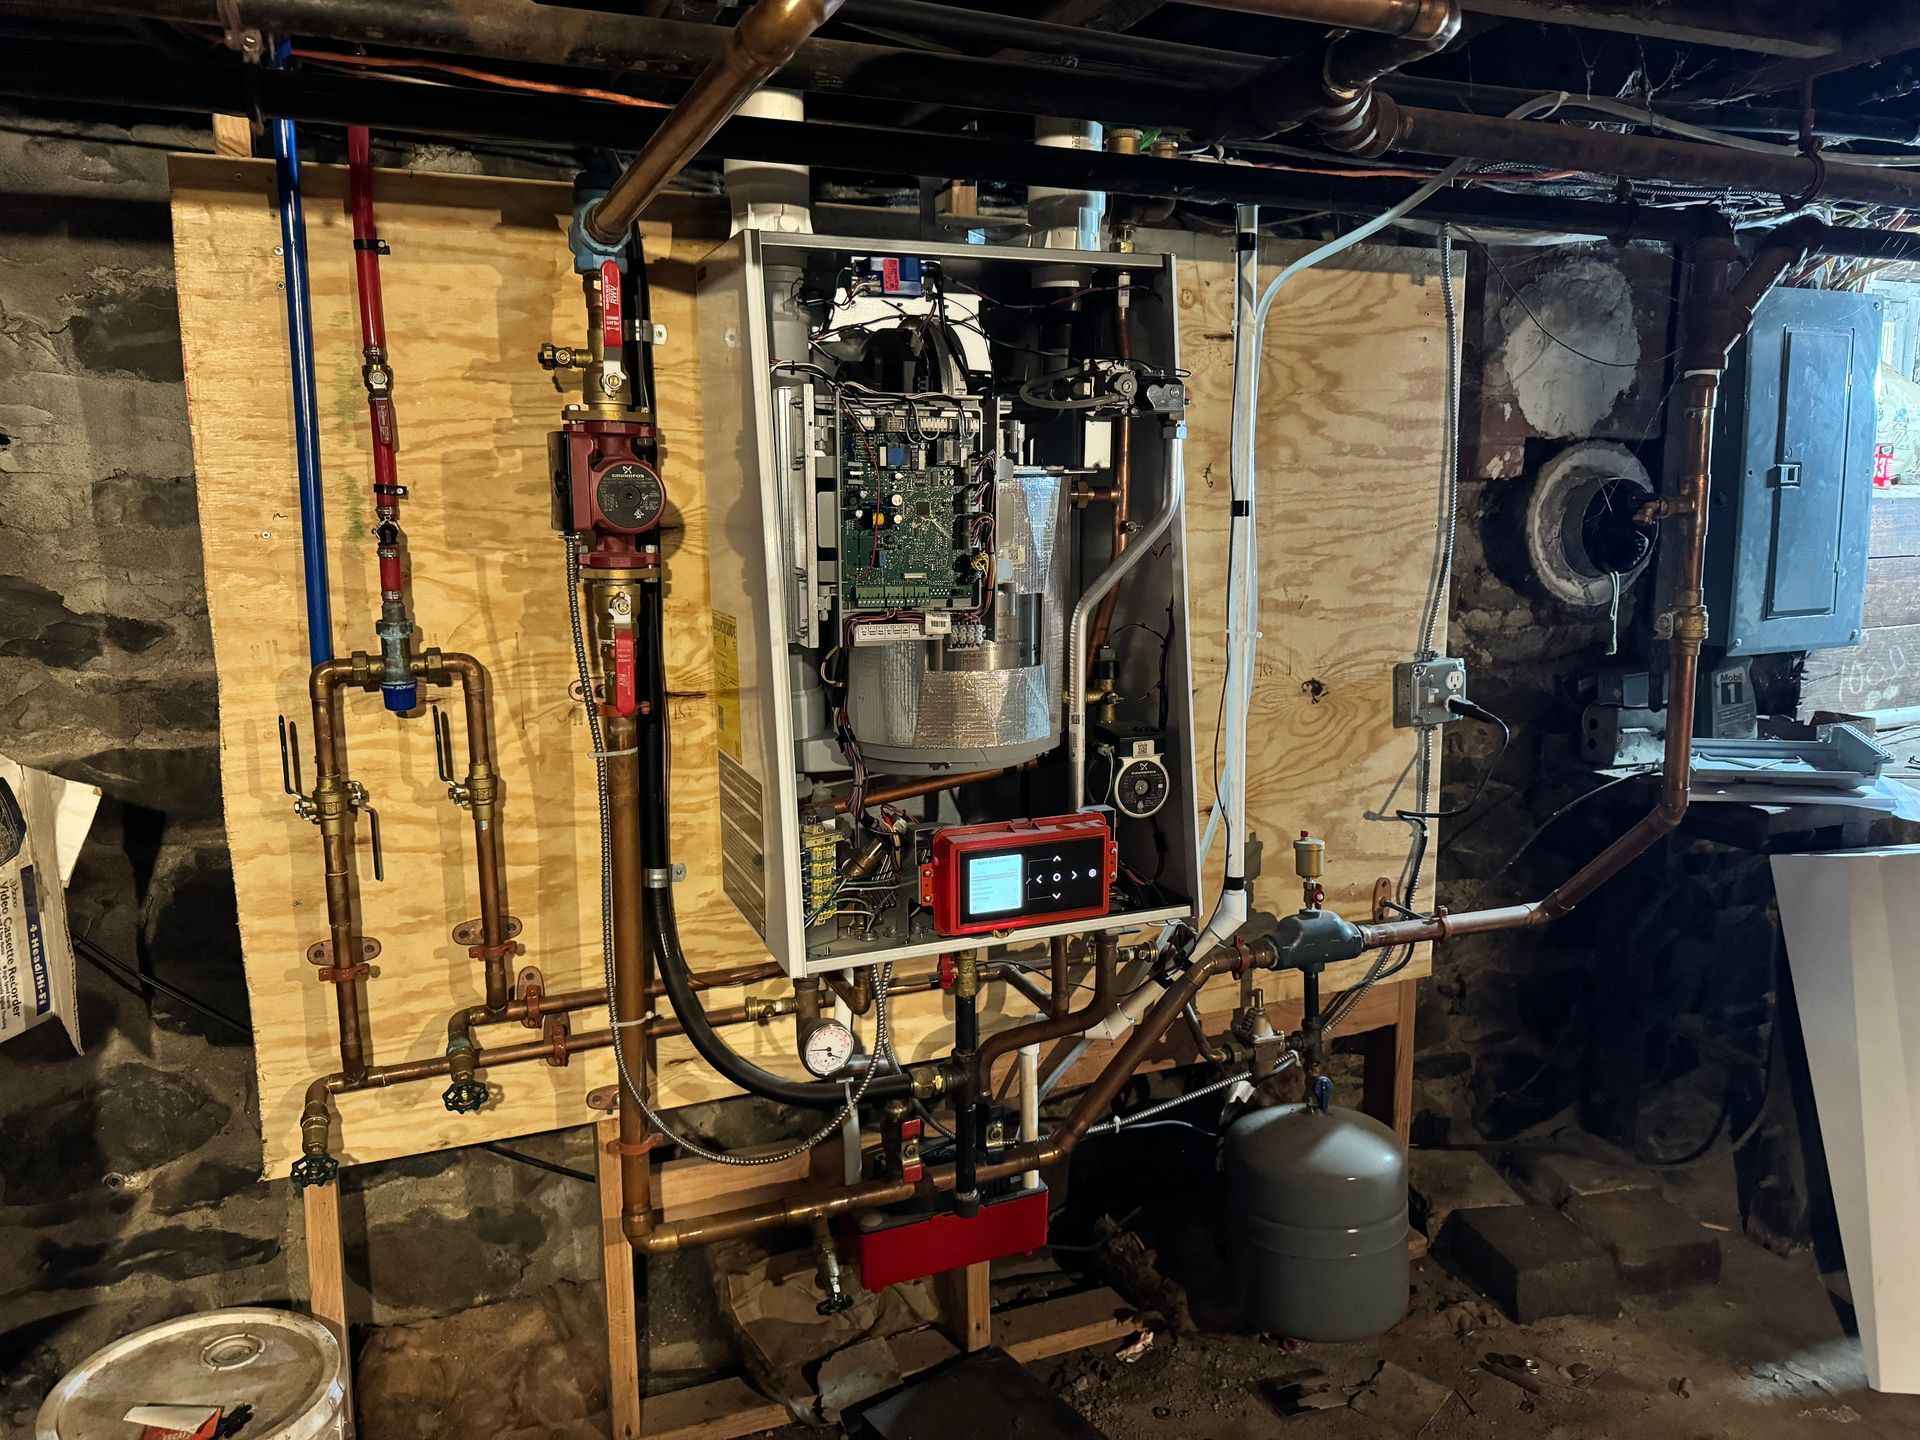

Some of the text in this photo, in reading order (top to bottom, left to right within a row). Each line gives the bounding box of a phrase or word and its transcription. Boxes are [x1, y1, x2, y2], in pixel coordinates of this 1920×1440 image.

[610, 285, 618, 305] RWV
[1720, 673, 1743, 682] Mobil
[1727, 683, 1736, 704] 1
[0, 880, 21, 1017] Video Cassette Recorder
[30, 923, 47, 1006] 4-Head/Hi-Fi
